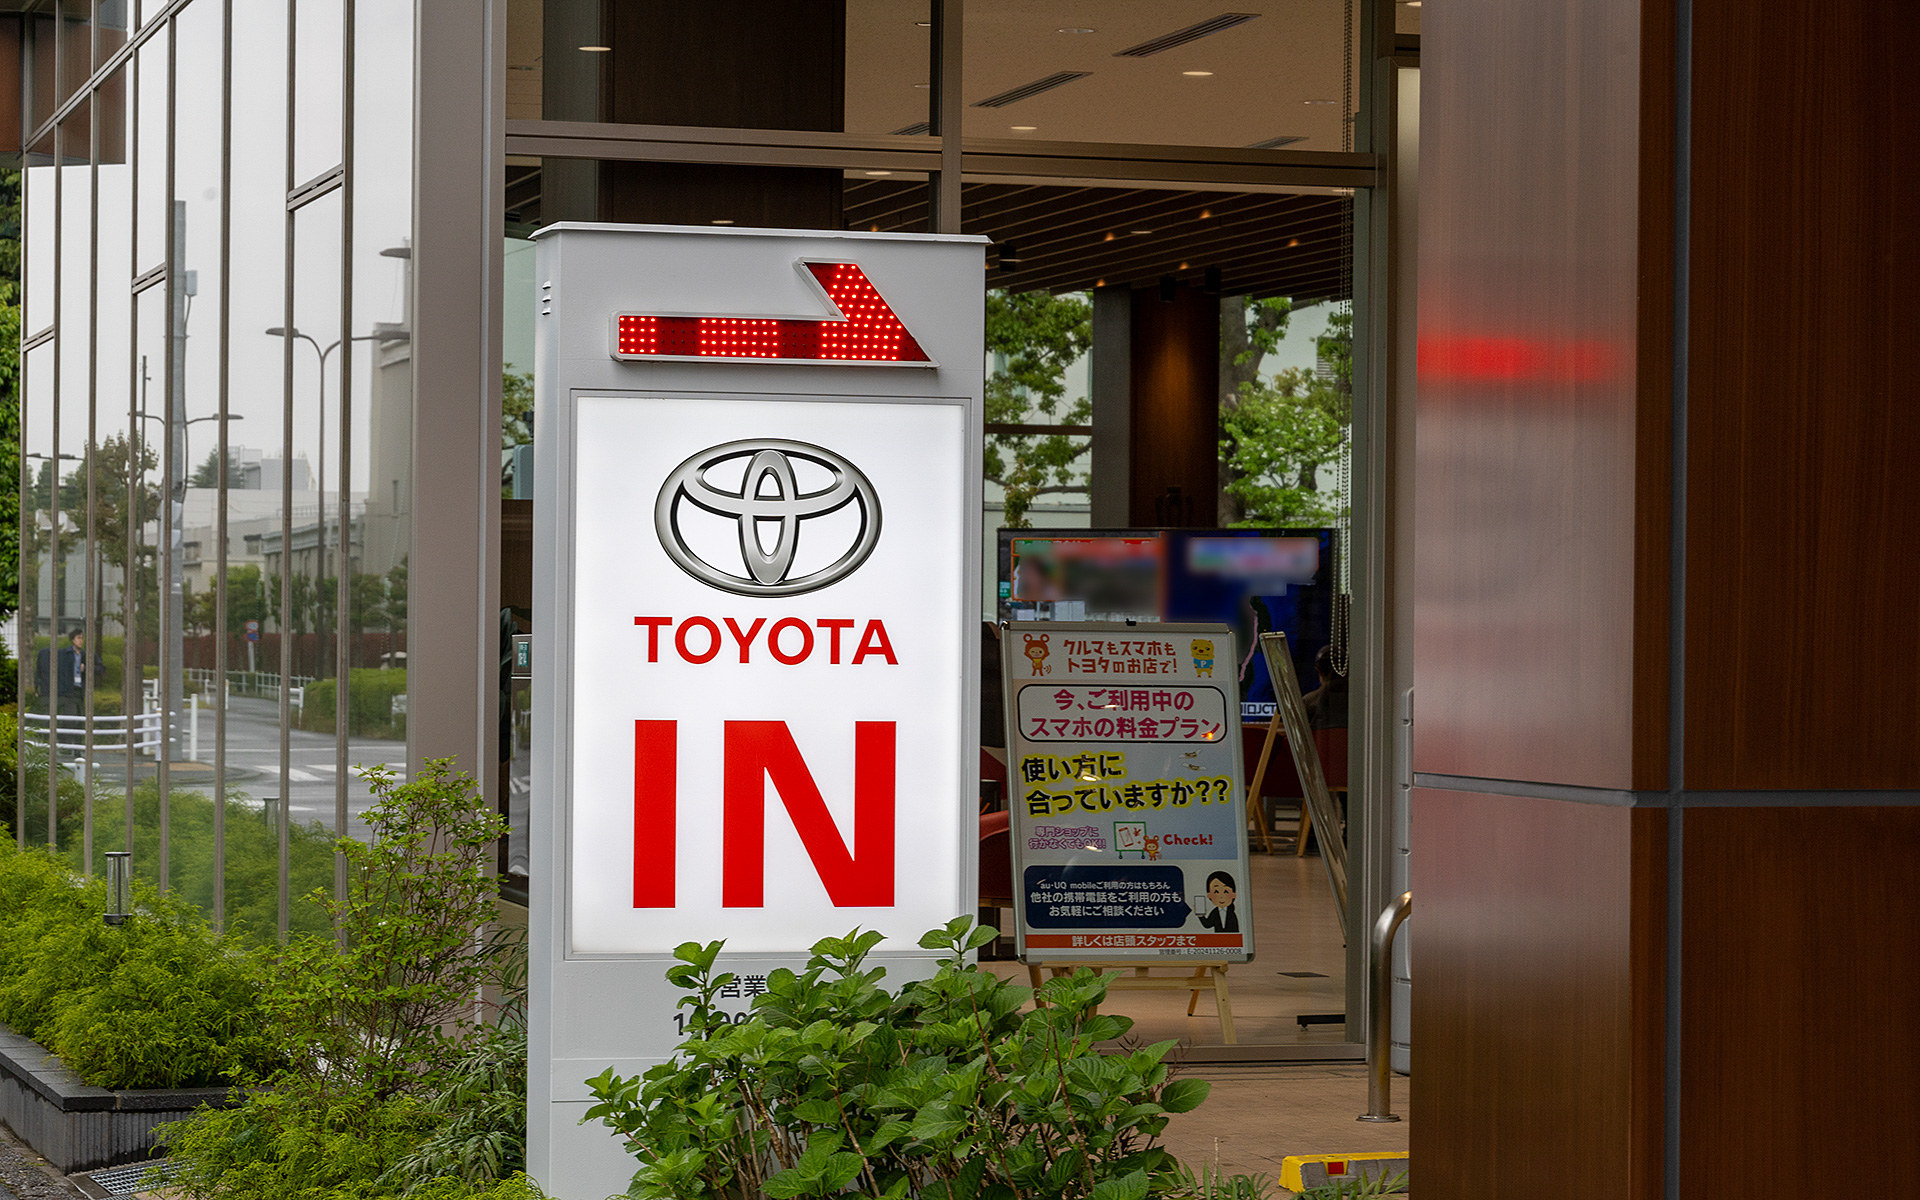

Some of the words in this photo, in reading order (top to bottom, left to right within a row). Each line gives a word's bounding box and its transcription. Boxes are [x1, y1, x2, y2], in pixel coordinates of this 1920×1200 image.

[634, 616, 899, 665] TOYOTA
[1063, 639, 1176, 656] クルマもスマホも
[1053, 688, 1194, 711] 今、ご利用中の
[1029, 716, 1221, 739] スマホの料金プラン
[1021, 754, 1124, 783] 使い方に
[633, 719, 896, 909] IN
[1034, 826, 1099, 838] 専門ショップに
[1163, 833, 1213, 846] Check!
[1070, 880, 1171, 890] mobileご利用の方はもちろん
[1030, 891, 1182, 903] 他社の携帯電話をご利用の方も
[1049, 905, 1165, 917] お気軽にご相談ください
[1072, 935, 1197, 947] 詳しくは店頭スタッフまで
